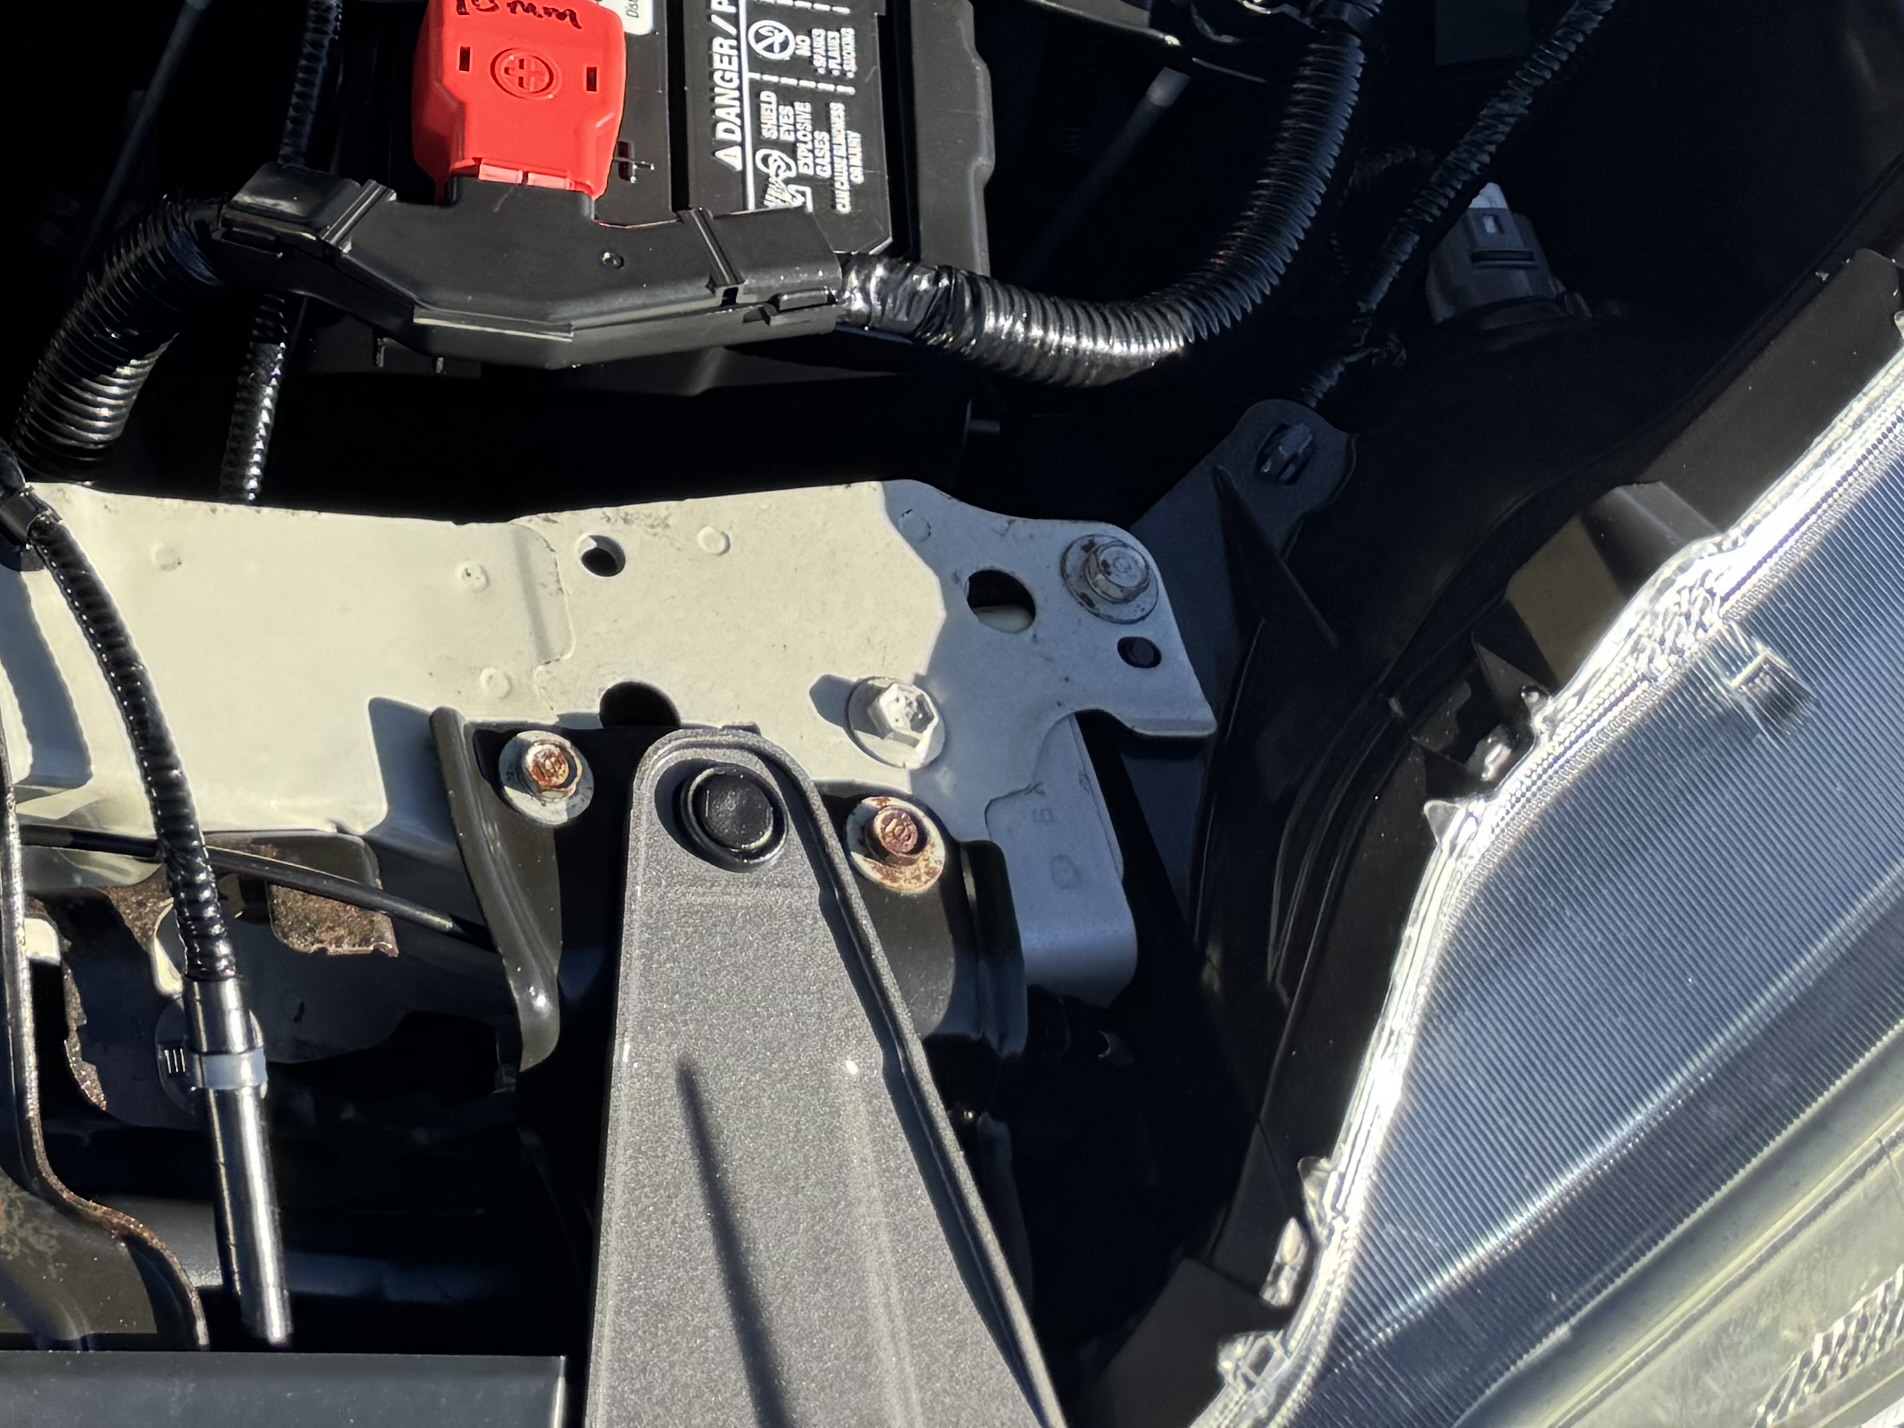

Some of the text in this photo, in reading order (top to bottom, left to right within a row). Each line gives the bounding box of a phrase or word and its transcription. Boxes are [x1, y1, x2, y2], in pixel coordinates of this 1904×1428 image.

[796, 35, 811, 56] NO
[711, 36, 743, 142] DANGER
[760, 90, 779, 140] SHIELD
[780, 105, 795, 142] EYES
[795, 102, 814, 176] EXPLOSIVE
[814, 130, 831, 178] GASES
[833, 155, 849, 190] CAUSE
[836, 191, 851, 213] CAN
